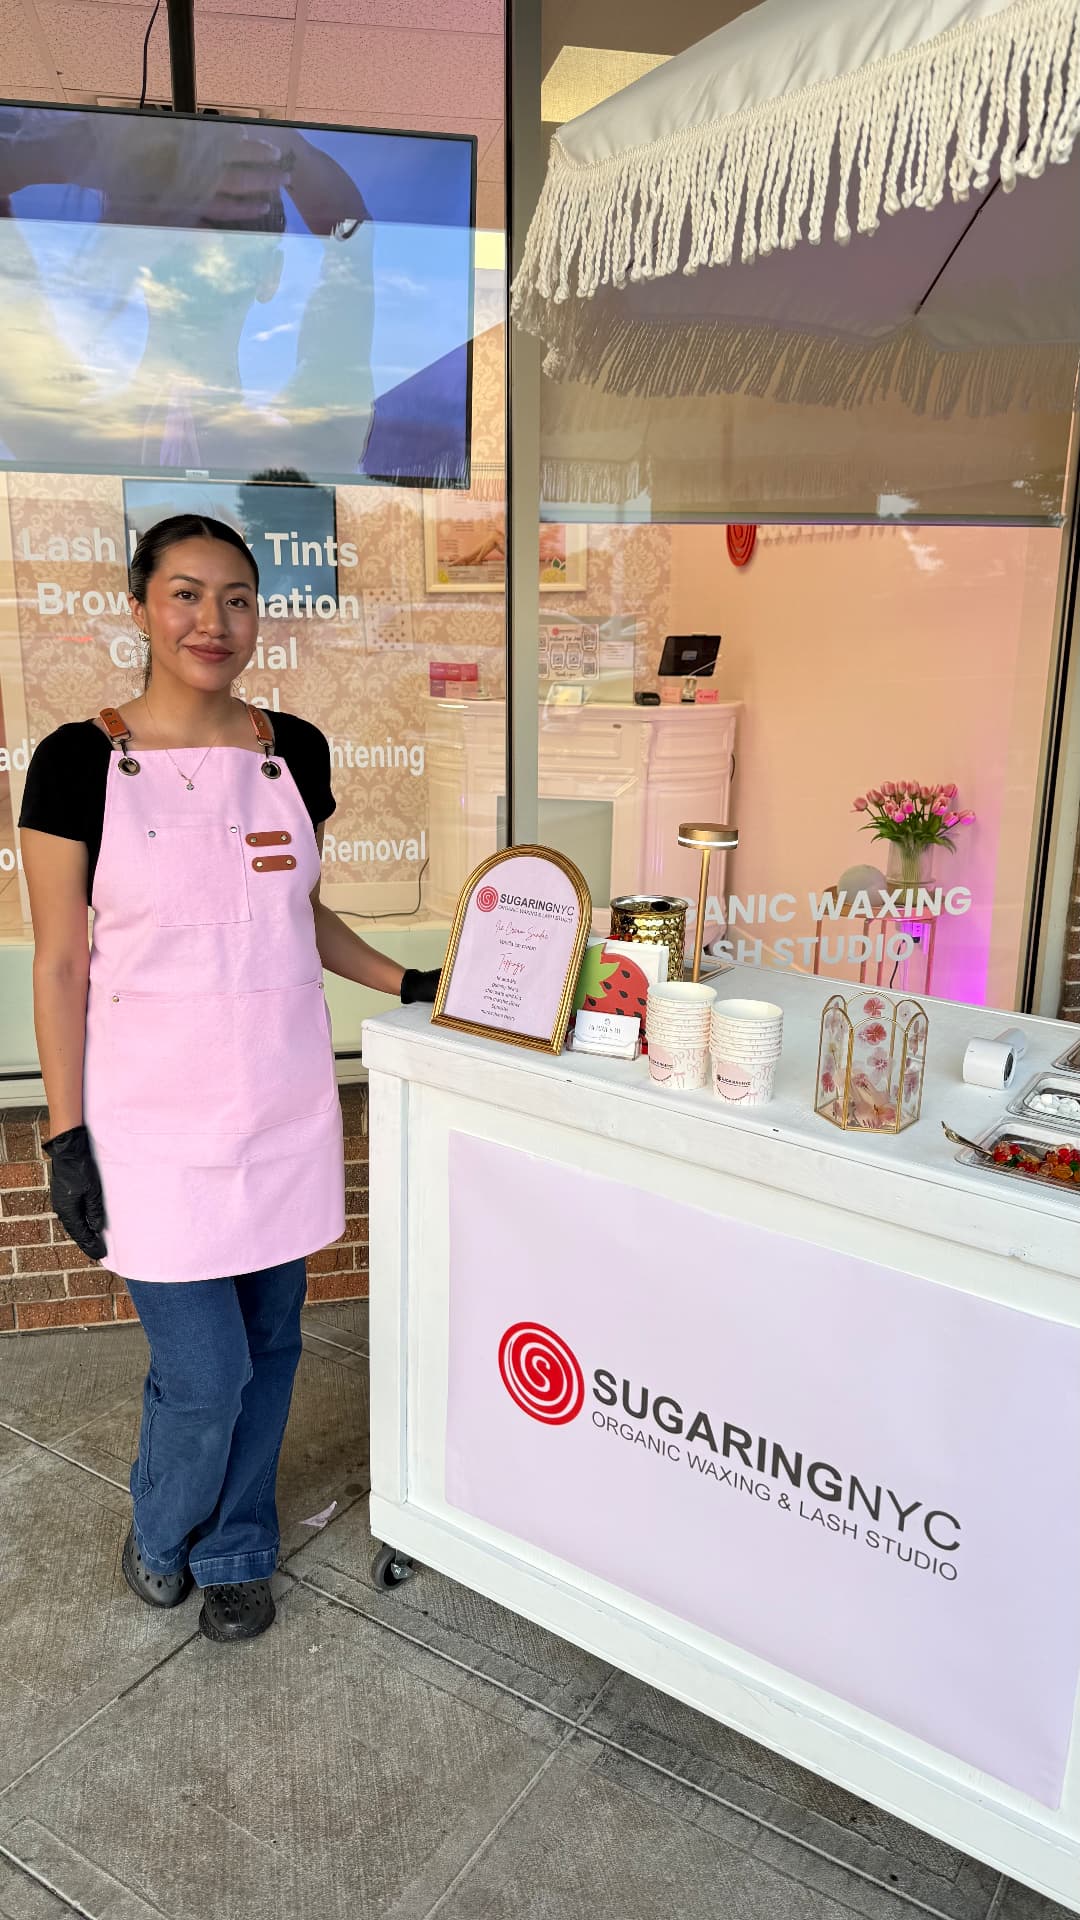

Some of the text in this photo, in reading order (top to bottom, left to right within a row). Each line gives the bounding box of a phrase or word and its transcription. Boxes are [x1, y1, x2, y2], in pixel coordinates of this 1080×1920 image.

[22, 527, 118, 562] Lash
[264, 531, 359, 568] Tints
[257, 585, 359, 620] nation
[328, 736, 425, 776] htening
[321, 831, 426, 862] Removal
[499, 893, 575, 916] SUGARINGNYC
[808, 886, 972, 922] WAXING
[772, 933, 915, 967] STUDIO
[592, 1368, 962, 1552] SUGARINGNYC
[592, 1411, 958, 1581] ORGANIC WAXING & LASH STUDIO
